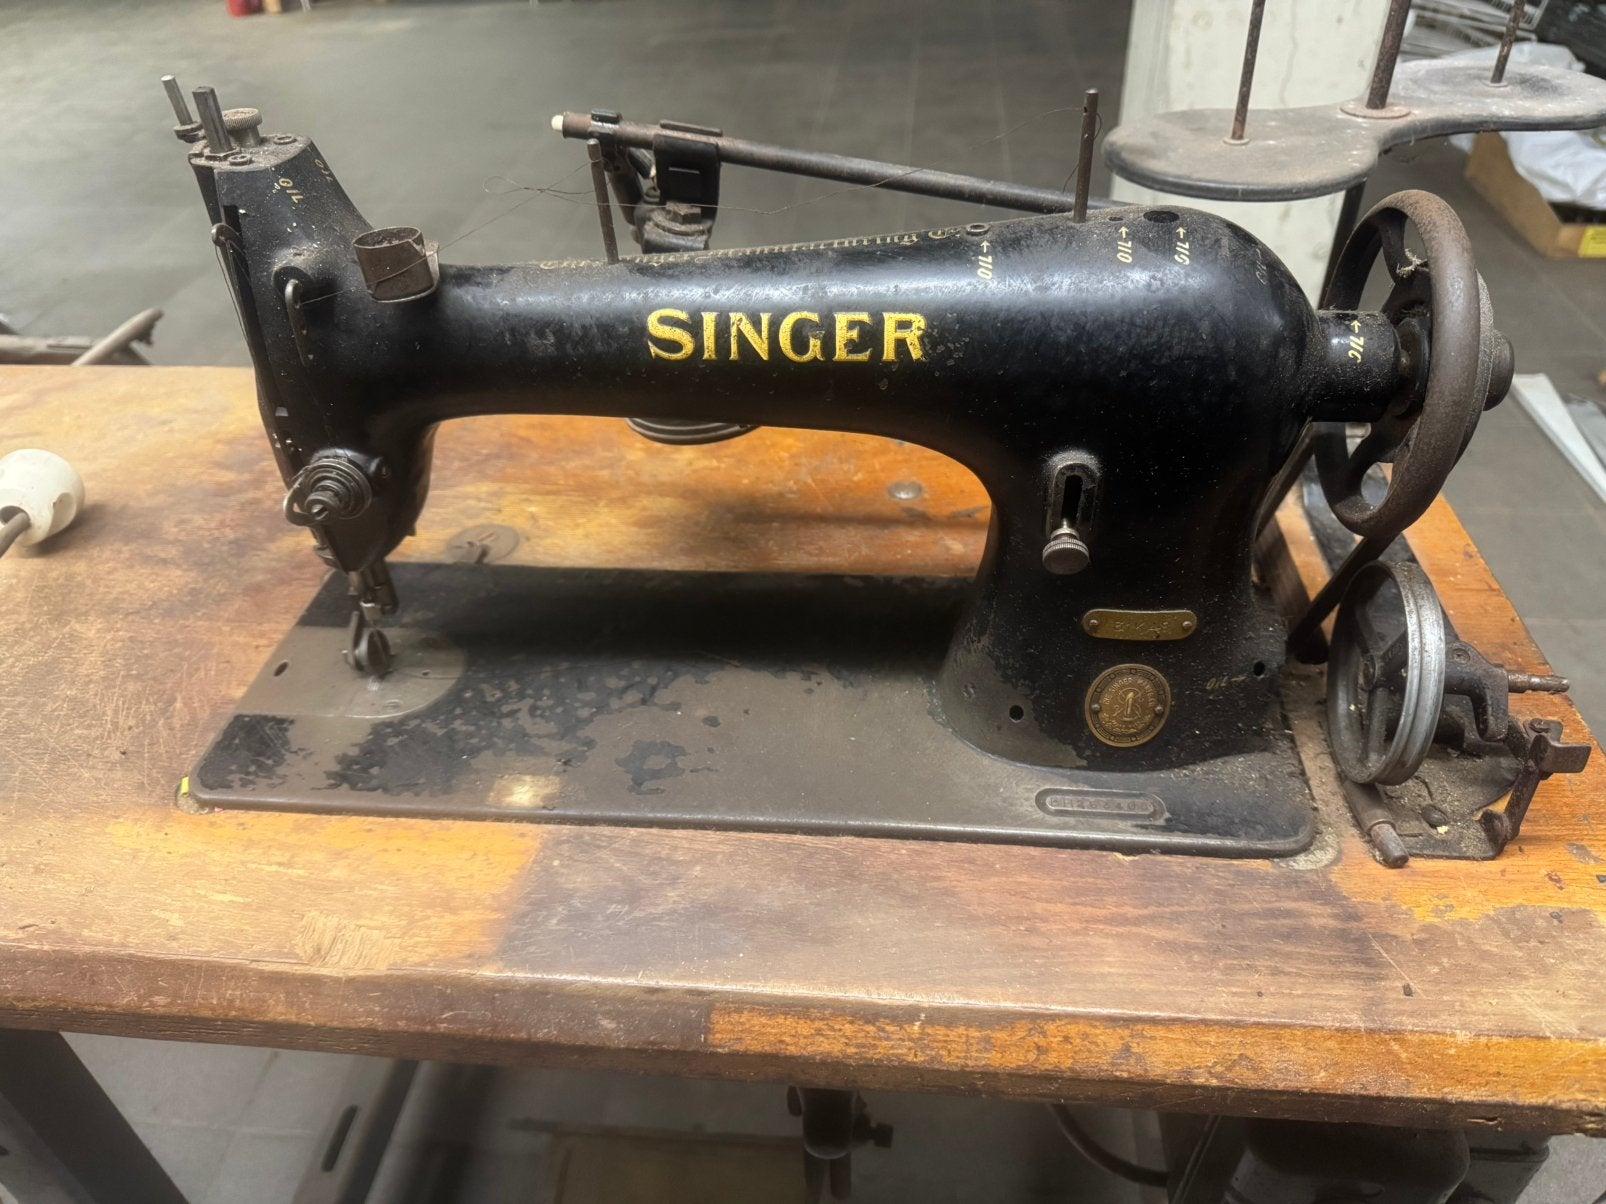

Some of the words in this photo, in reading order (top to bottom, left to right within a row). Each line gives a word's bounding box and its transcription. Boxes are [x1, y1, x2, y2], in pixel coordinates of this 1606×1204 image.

[279, 178, 304, 204] OIL
[1116, 241, 1133, 264] OIL
[976, 255, 992, 280] OIL
[646, 308, 929, 363] SINGER
